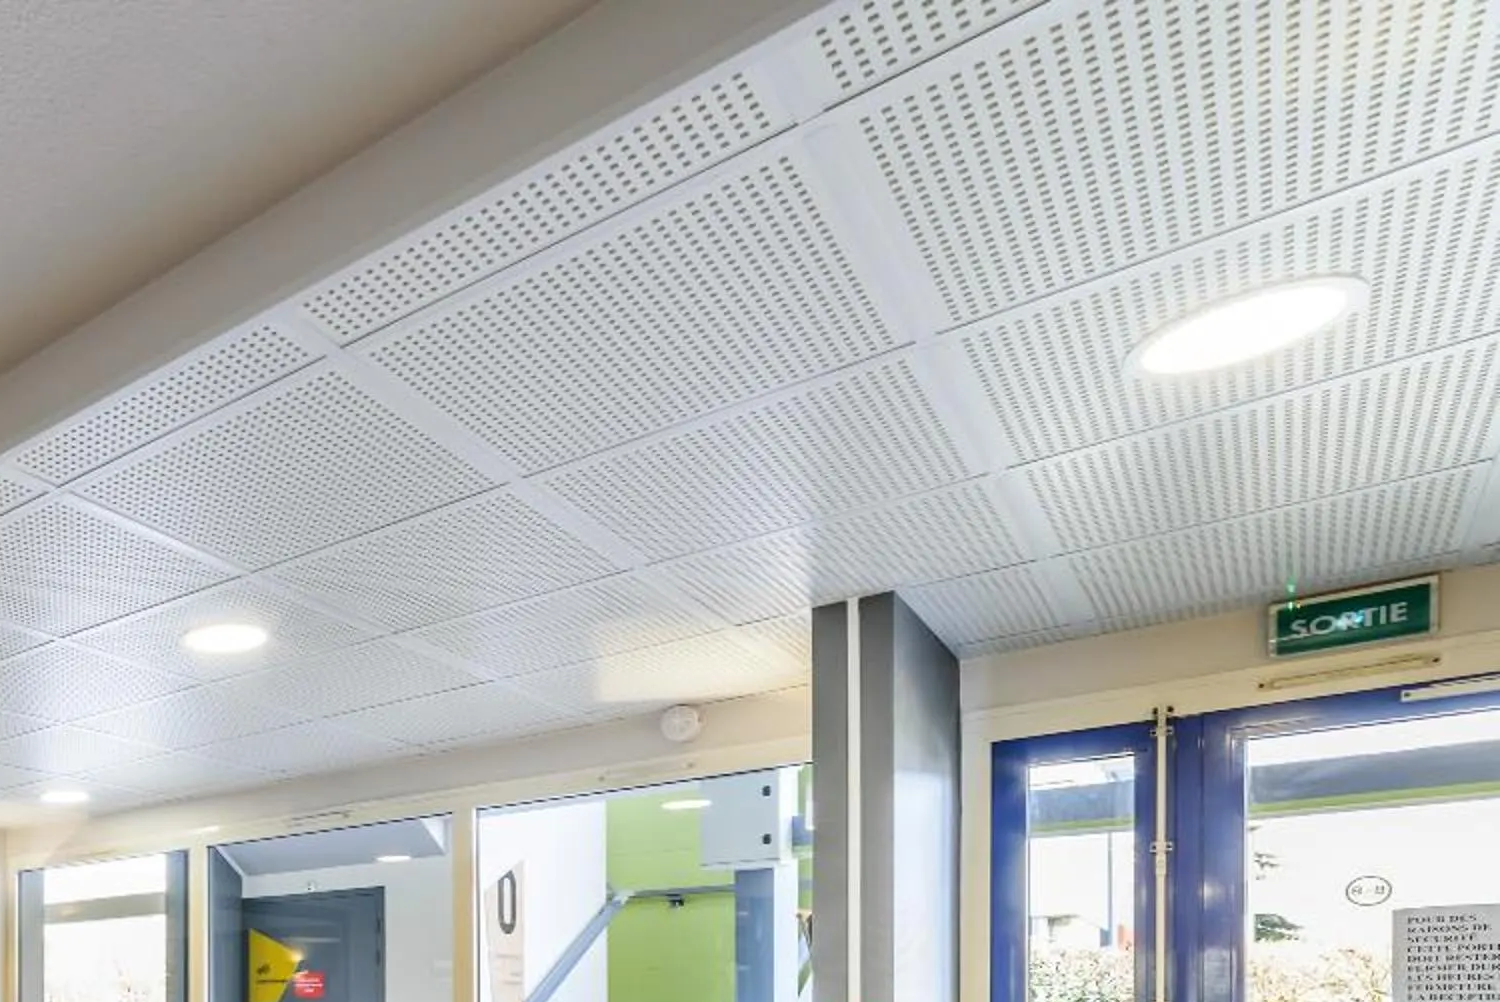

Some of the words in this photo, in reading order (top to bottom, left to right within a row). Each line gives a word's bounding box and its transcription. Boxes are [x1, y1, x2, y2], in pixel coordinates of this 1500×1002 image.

[1291, 601, 1408, 635] SORTIE
[1407, 915, 1445, 924] POUR
[1449, 915, 1477, 923] DES
[1407, 925, 1469, 933] RAISONS
[1473, 923, 1492, 931] DE
[1407, 945, 1450, 953] CETTE
[1407, 955, 1441, 963] DOIT
